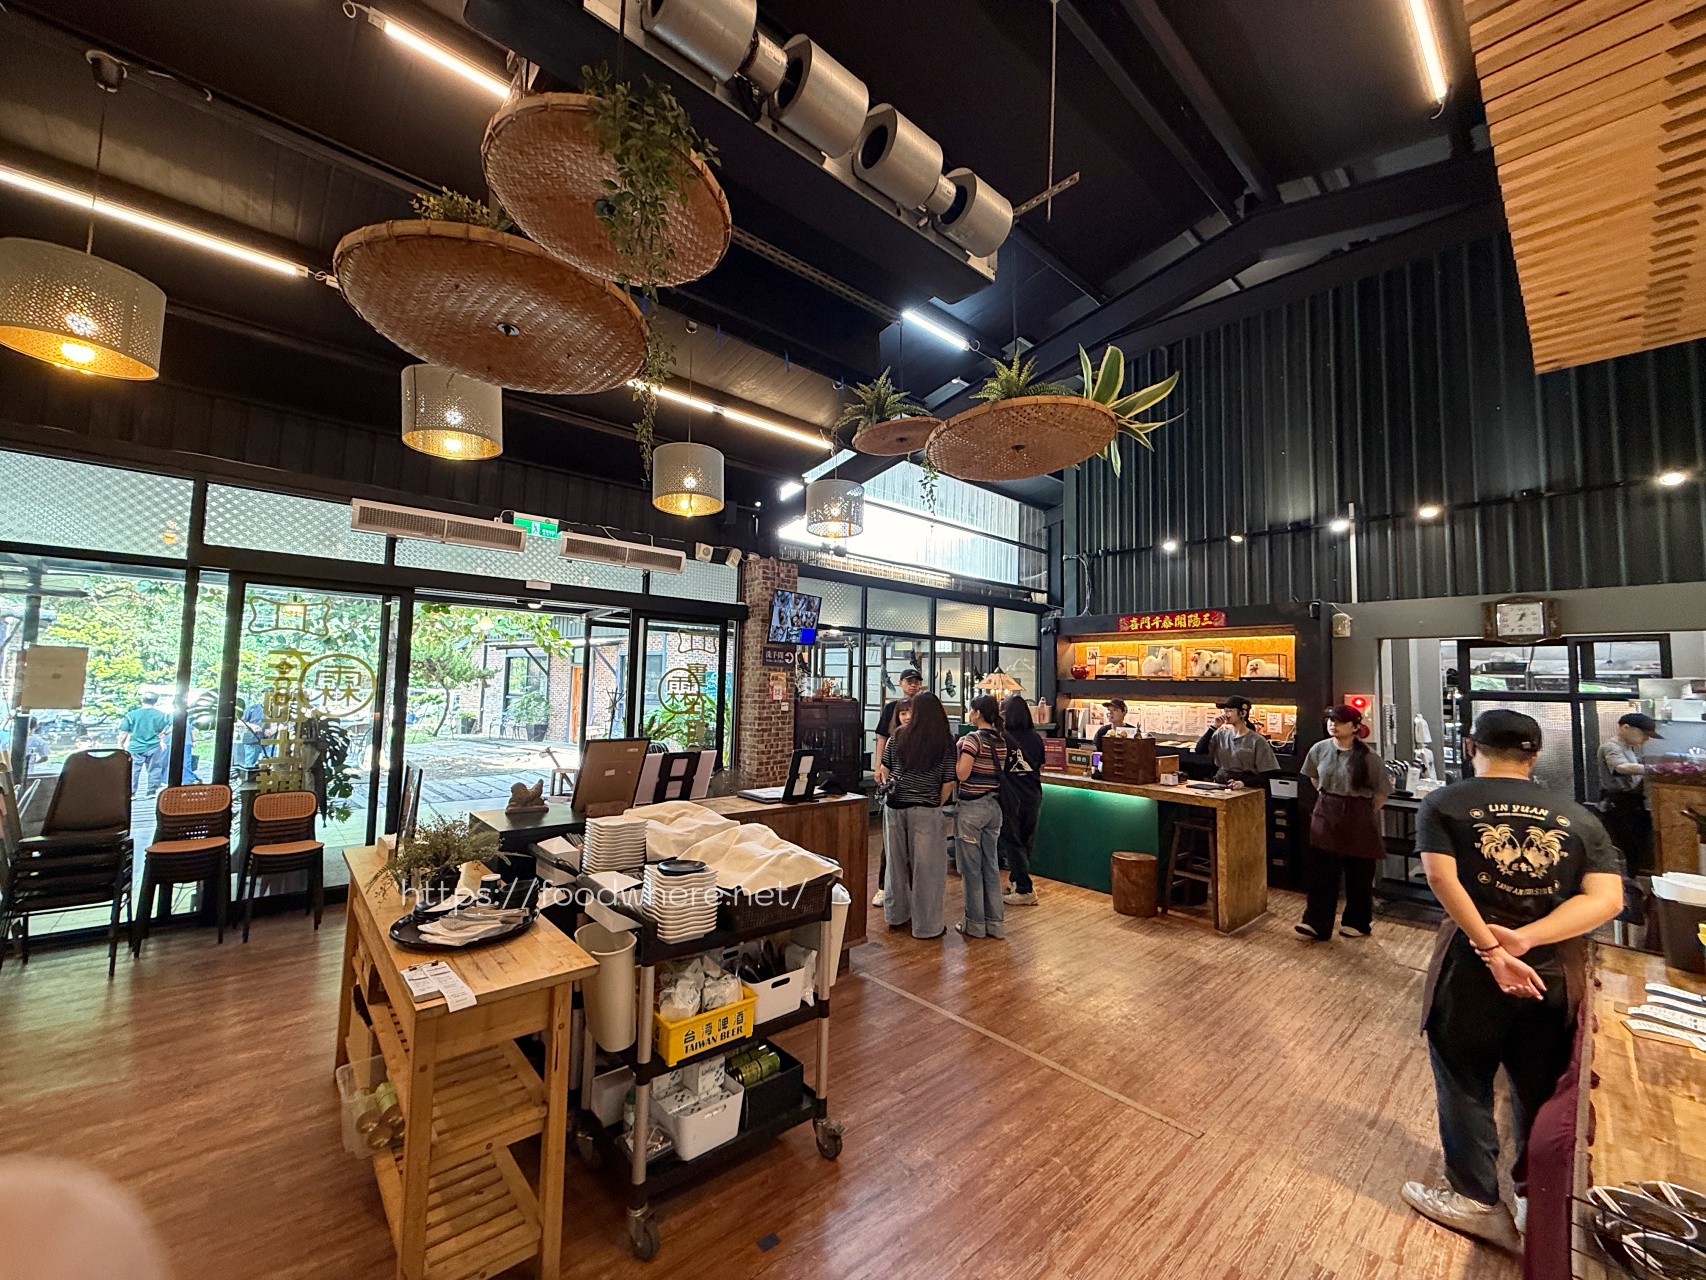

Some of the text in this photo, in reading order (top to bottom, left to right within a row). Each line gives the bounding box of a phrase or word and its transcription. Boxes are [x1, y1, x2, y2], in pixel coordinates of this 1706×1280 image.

[1488, 804, 1549, 816] LIN YUAN
[684, 1025, 743, 1054] TAIWAN BEER
